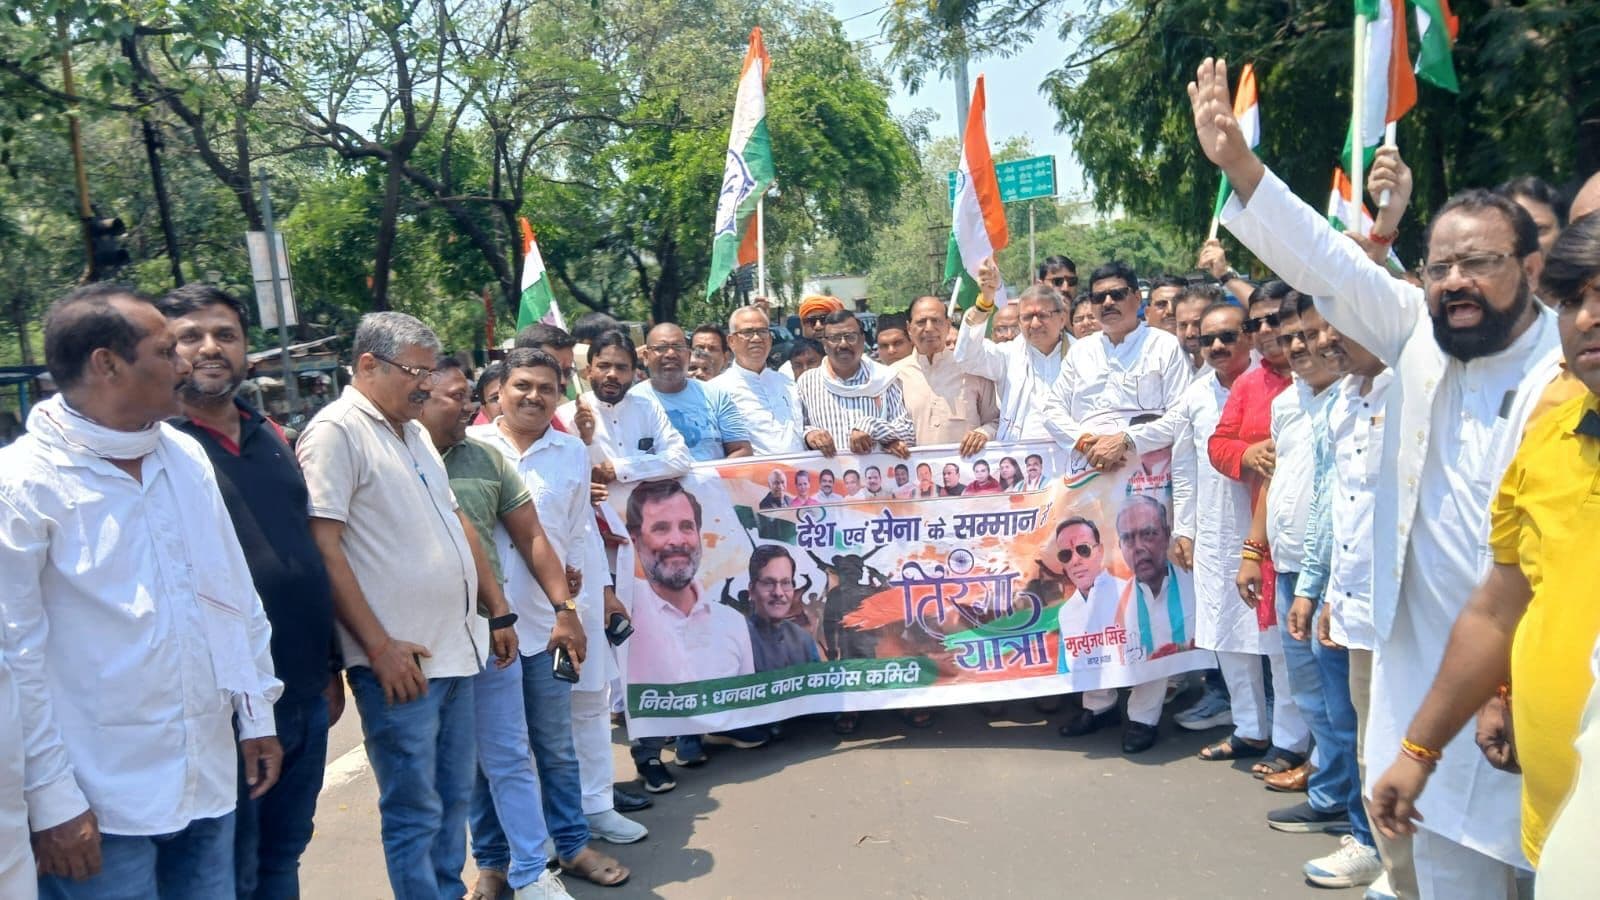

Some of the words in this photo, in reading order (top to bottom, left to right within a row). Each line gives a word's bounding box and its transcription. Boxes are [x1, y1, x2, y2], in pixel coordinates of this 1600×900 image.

[797, 515, 836, 549] देश
[843, 523, 869, 546] एवं
[871, 509, 921, 543] सेना
[927, 517, 946, 540] के
[953, 508, 1039, 539] सम्मान
[1039, 502, 1053, 527] में
[888, 548, 1042, 640] तिरंगा
[954, 631, 1049, 672] यात्रा
[1064, 631, 1104, 657] मृत्युंजय
[1105, 624, 1127, 646] सिंह
[638, 689, 698, 711] निवेदक
[712, 685, 767, 706] धनबाद
[771, 678, 804, 696] नगर
[807, 667, 861, 690] कांग्रेस
[866, 661, 921, 684] कमिटी
